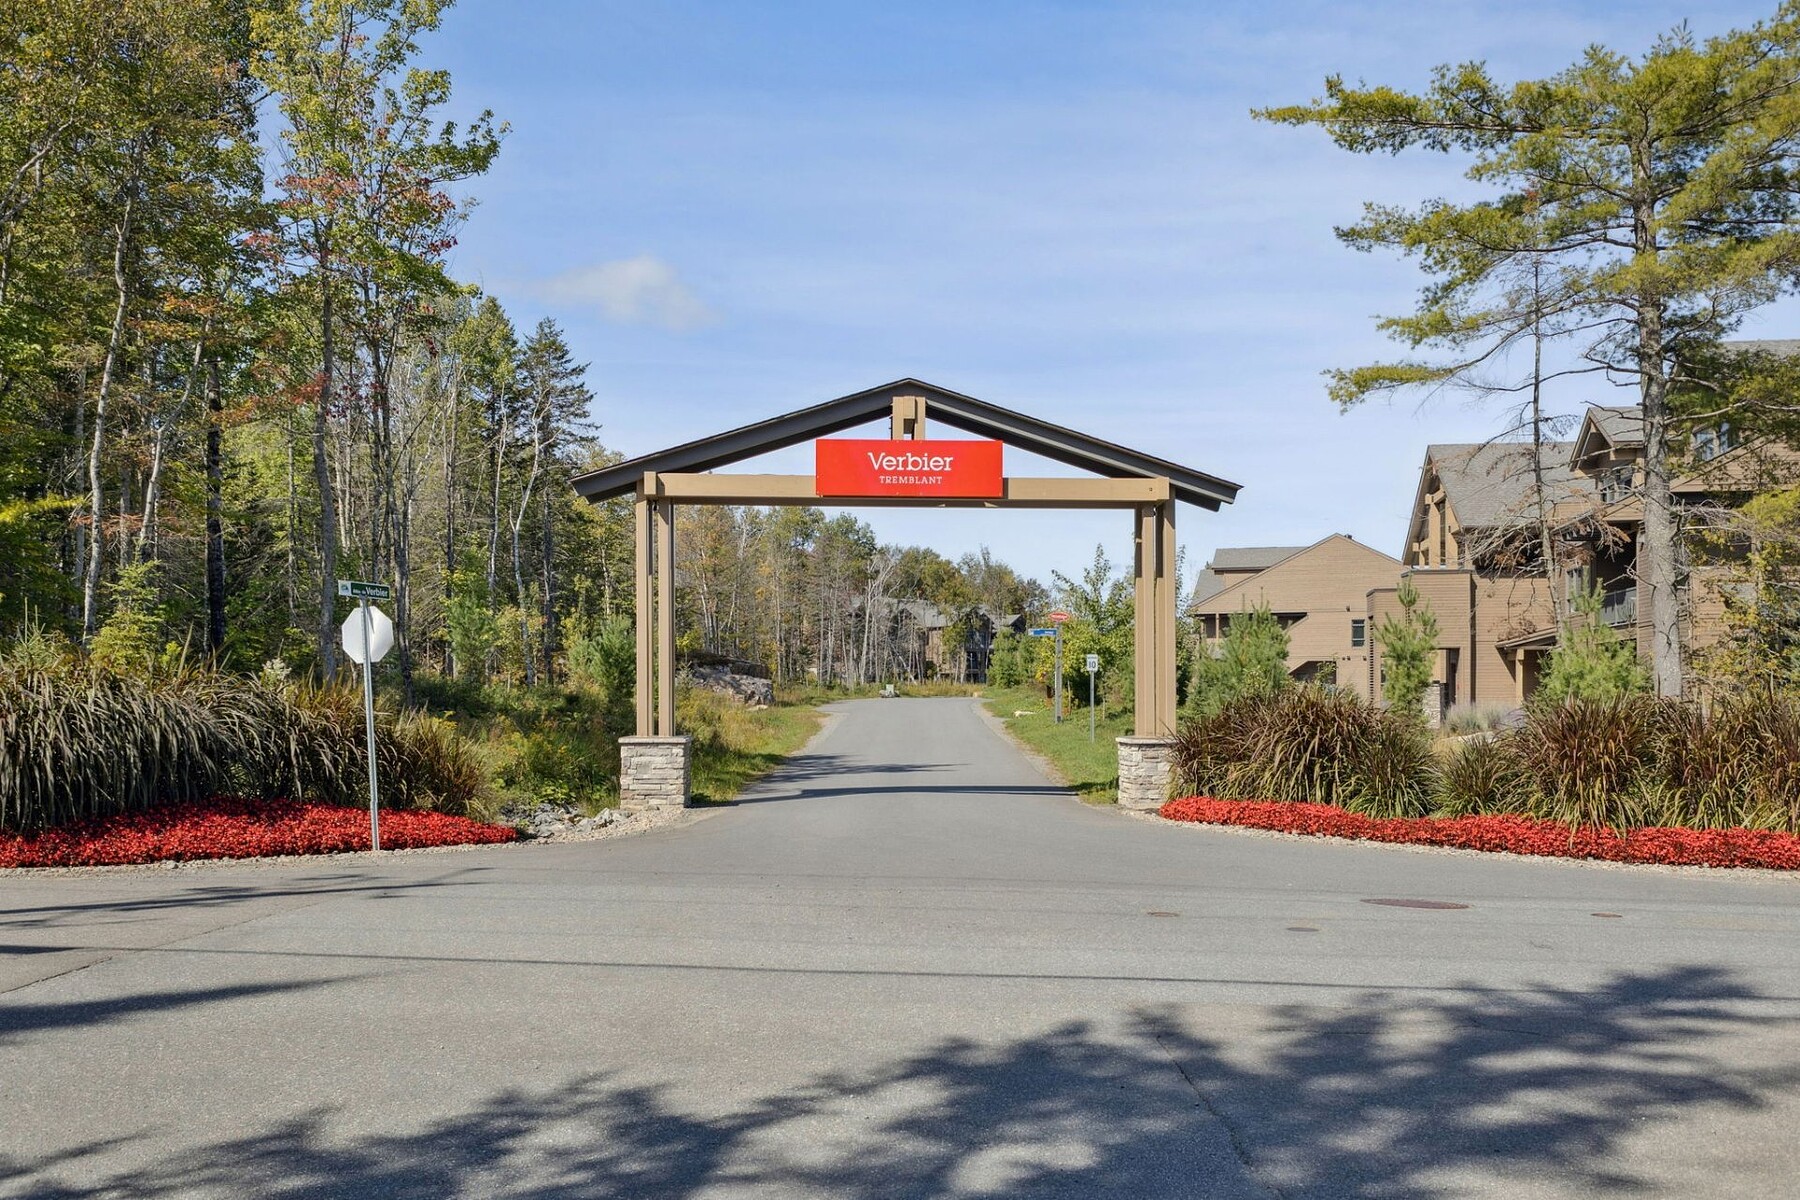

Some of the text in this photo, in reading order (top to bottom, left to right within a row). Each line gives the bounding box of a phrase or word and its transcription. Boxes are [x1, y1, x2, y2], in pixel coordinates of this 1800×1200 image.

[867, 452, 954, 471] Verbier
[879, 475, 943, 485] TREMBLANT
[365, 586, 388, 597] Verbier
